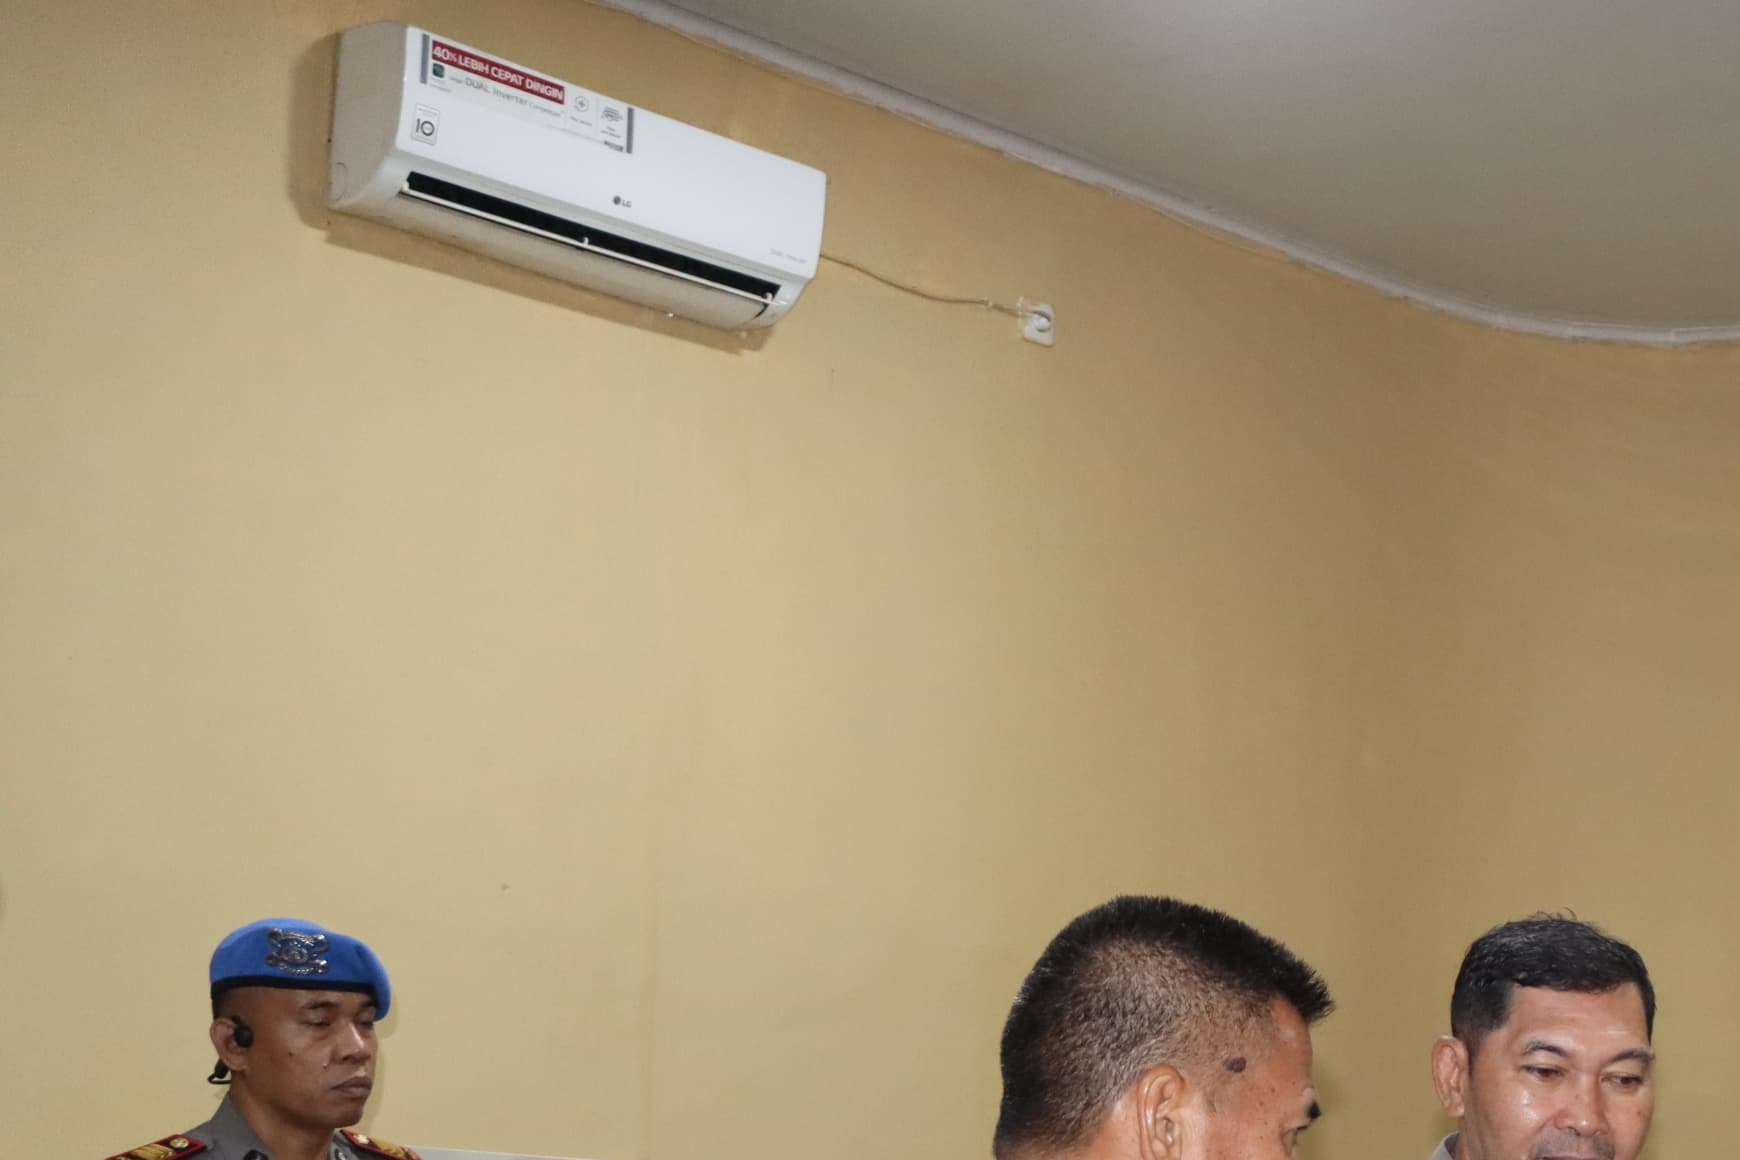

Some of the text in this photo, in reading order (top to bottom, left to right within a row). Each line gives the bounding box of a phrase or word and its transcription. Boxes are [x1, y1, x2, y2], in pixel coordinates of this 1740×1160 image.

[433, 46, 564, 100] 40% LEBIH CEPAT DINGIN
